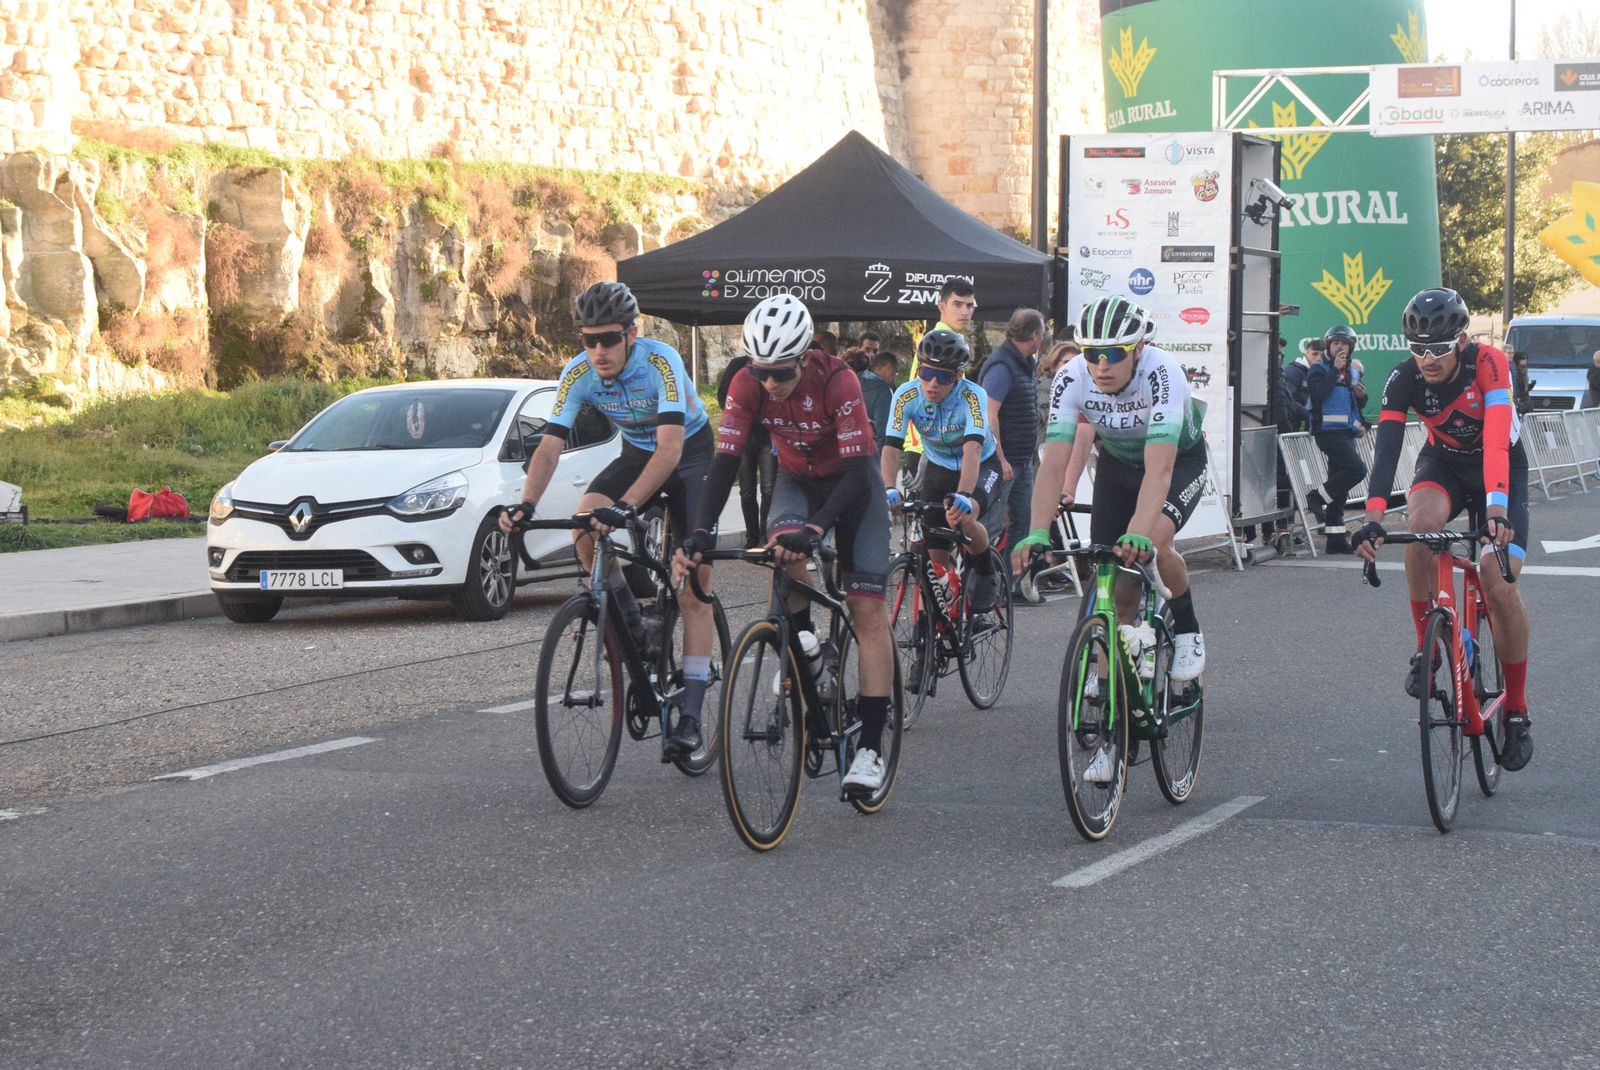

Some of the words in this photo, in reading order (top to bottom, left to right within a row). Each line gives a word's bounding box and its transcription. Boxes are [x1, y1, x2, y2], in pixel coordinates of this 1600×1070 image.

[1127, 100, 1177, 124] RURAL
[1186, 147, 1215, 155] VISTA
[1279, 190, 1408, 227] RURAL
[1052, 375, 1076, 409] RGA
[1157, 364, 1170, 406] SEGUROS
[1084, 400, 1114, 413] CAJA
[1116, 399, 1149, 413] RURAL
[1097, 414, 1145, 430] ALEA
[1415, 532, 1464, 541] CANYON
[270, 572, 306, 587] 7778
[311, 571, 340, 587] LCL
